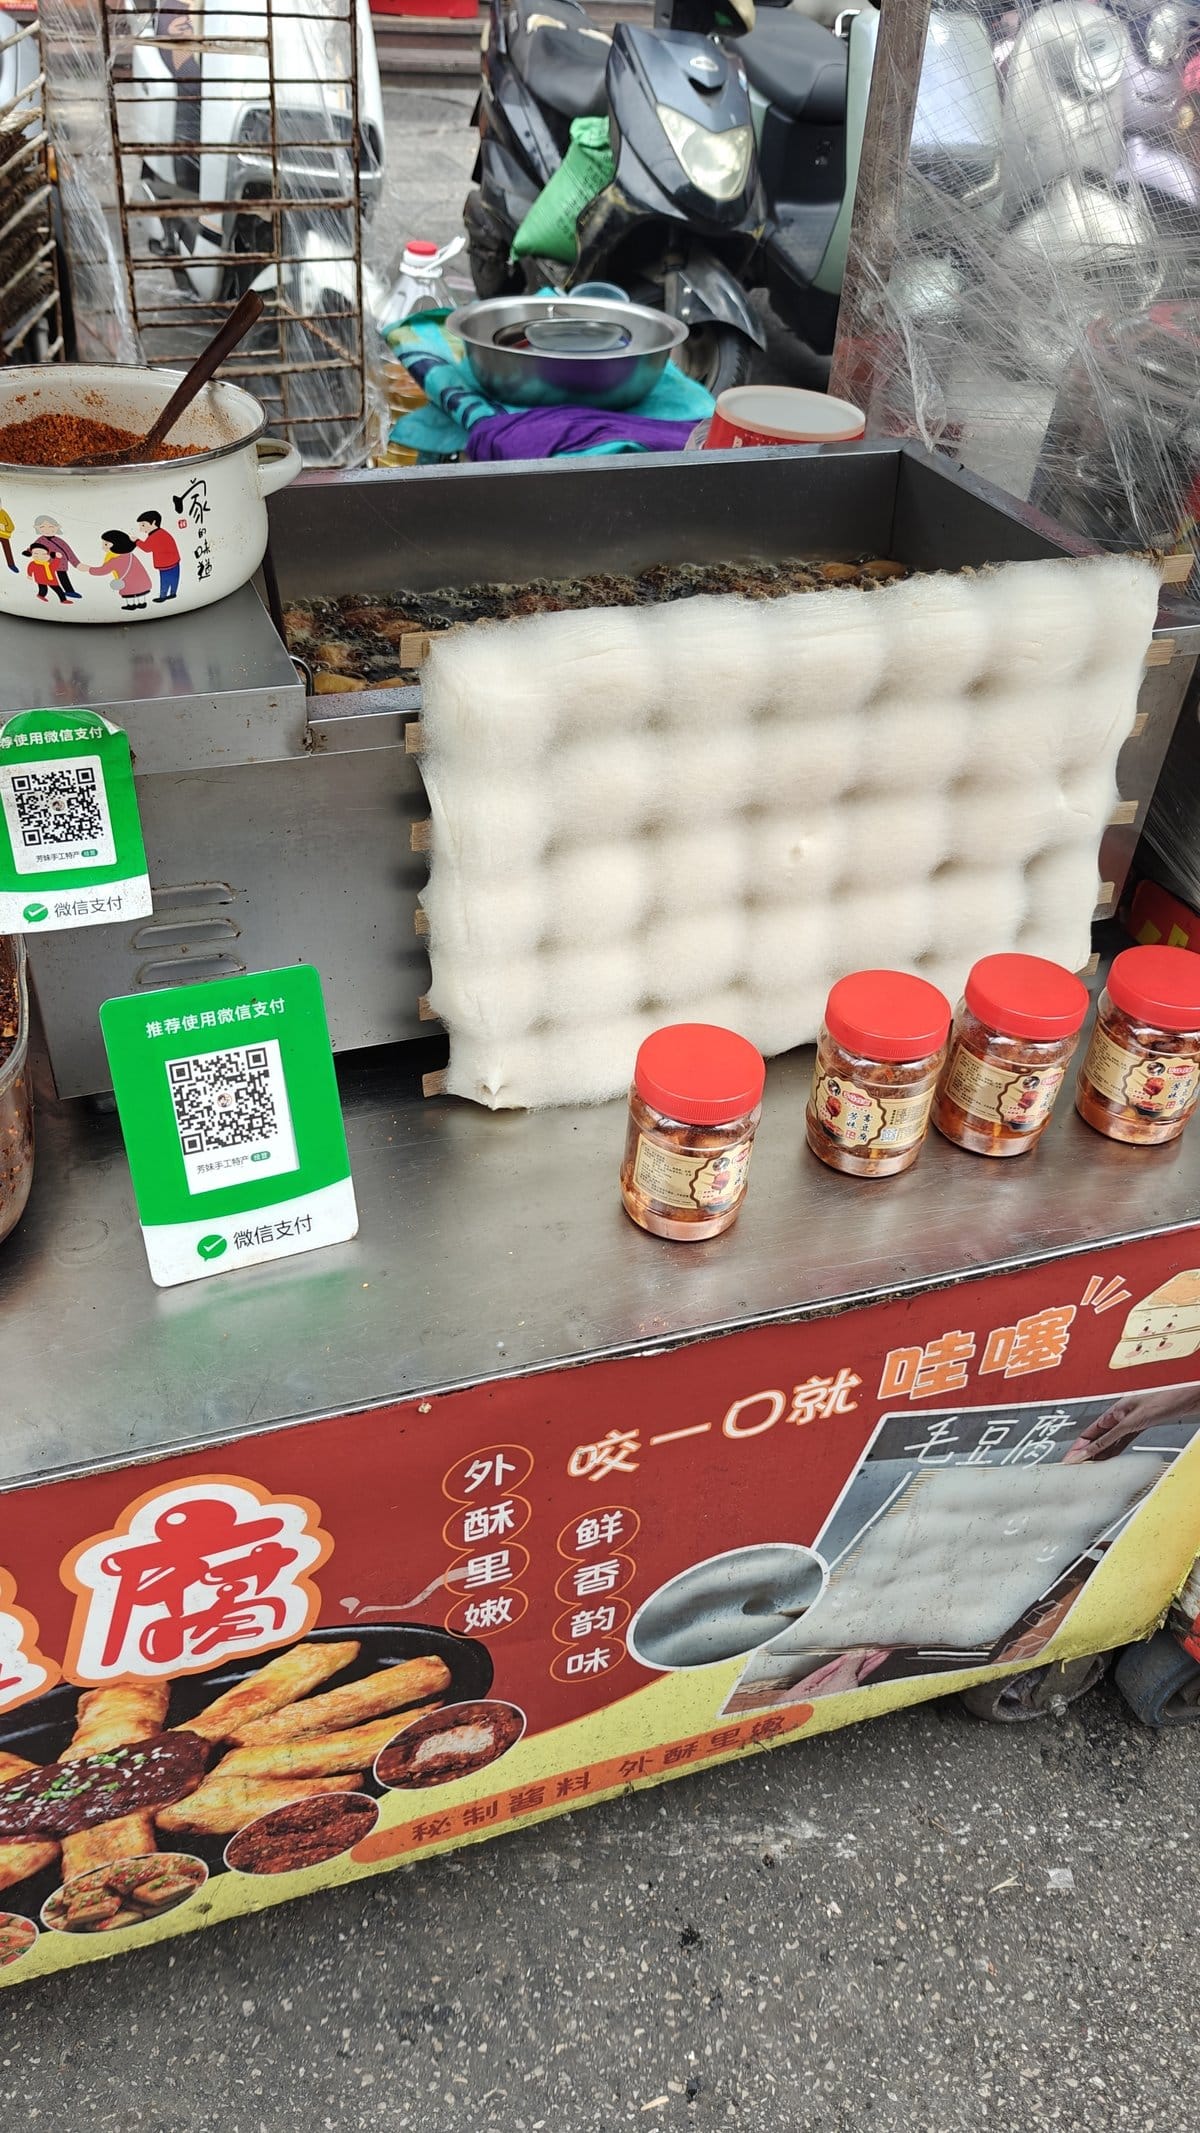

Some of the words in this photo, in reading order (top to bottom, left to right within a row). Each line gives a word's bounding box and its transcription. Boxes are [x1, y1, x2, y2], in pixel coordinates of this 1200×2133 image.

[172, 478, 212, 581] 家的味道
[54, 895, 123, 918] 微信支付
[145, 997, 286, 1039] 推荐使用微信支付
[232, 1213, 313, 1250] 微信支付
[566, 1366, 863, 1483] 咬一口就
[903, 1409, 1078, 1471] 毛豆腐
[463, 1452, 517, 1634] 外酥里嫩
[566, 1510, 625, 1675] 鲜香韵味
[0, 1498, 300, 1692] 腐
